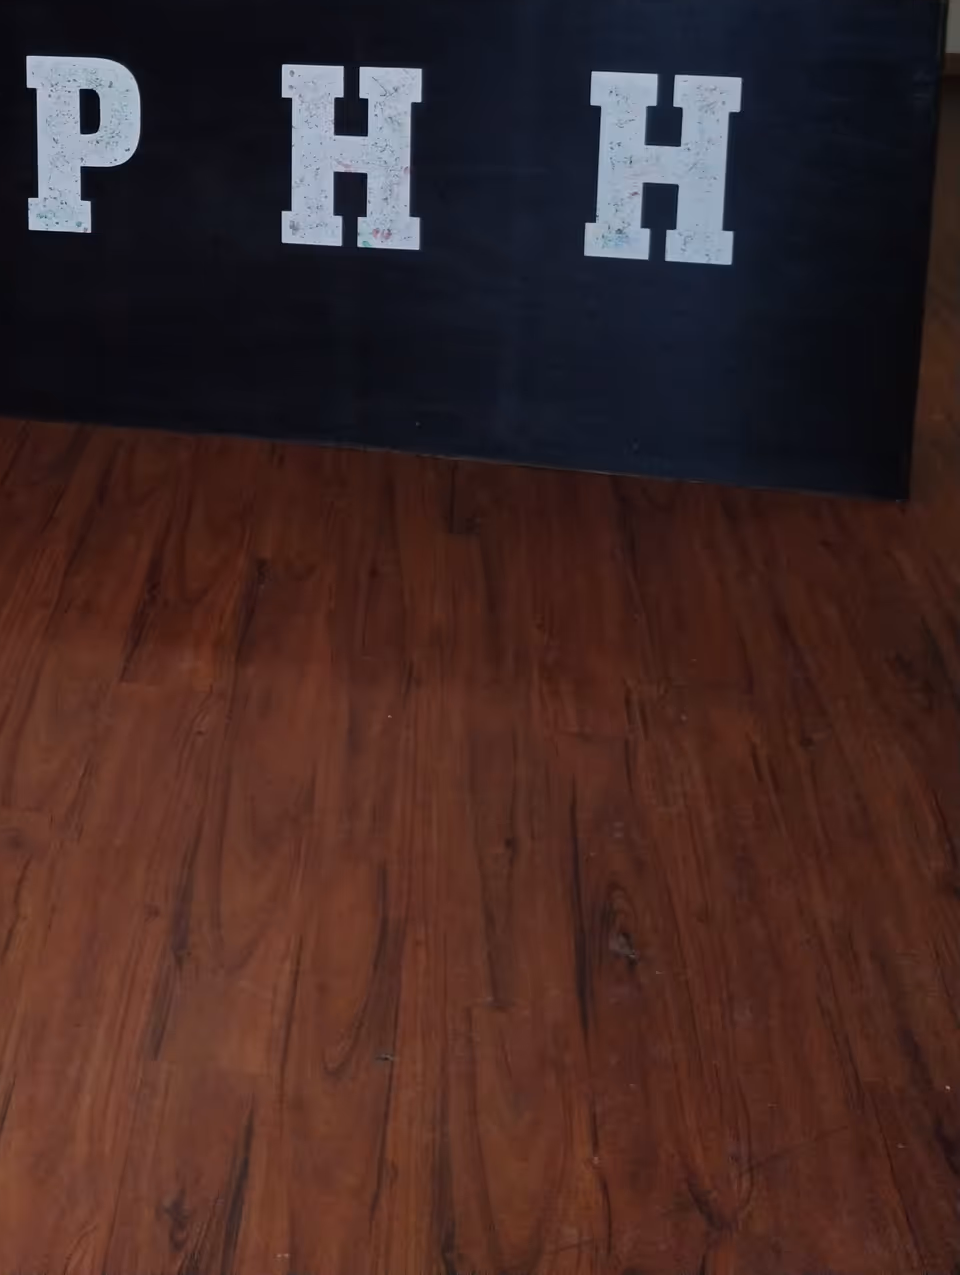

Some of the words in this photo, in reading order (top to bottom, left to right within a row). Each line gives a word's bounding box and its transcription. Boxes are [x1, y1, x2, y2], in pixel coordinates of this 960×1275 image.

[26, 56, 141, 233] P
[282, 63, 423, 250] H
[584, 71, 743, 265] H
